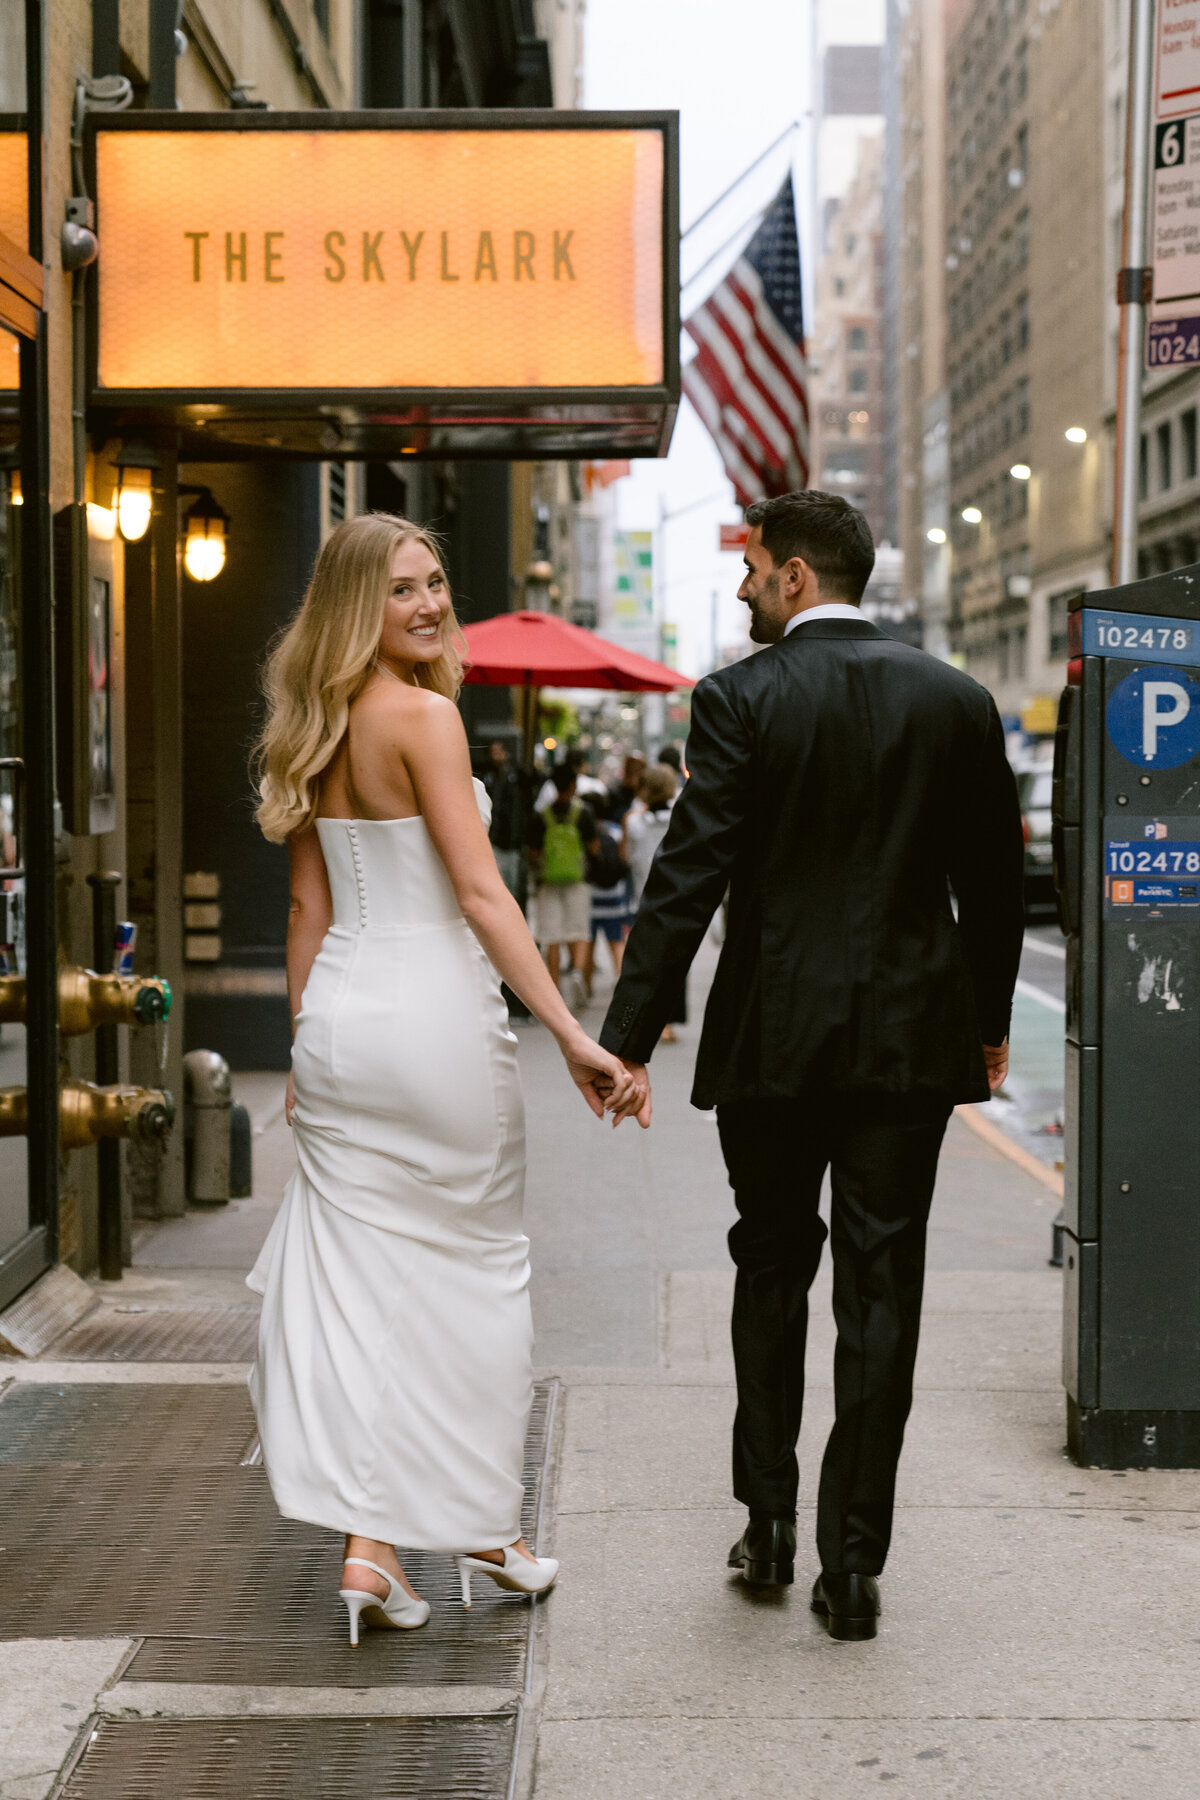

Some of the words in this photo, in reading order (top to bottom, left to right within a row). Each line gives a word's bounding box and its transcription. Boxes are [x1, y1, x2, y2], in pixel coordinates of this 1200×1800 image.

[1161, 124, 1180, 165] 6
[184, 231, 286, 283] THE
[324, 230, 577, 282] SKYLARK
[1151, 333, 1199, 363] 1024
[1098, 626, 1187, 650] 102478
[1143, 681, 1190, 754] P
[1110, 851, 1200, 873] 102478
